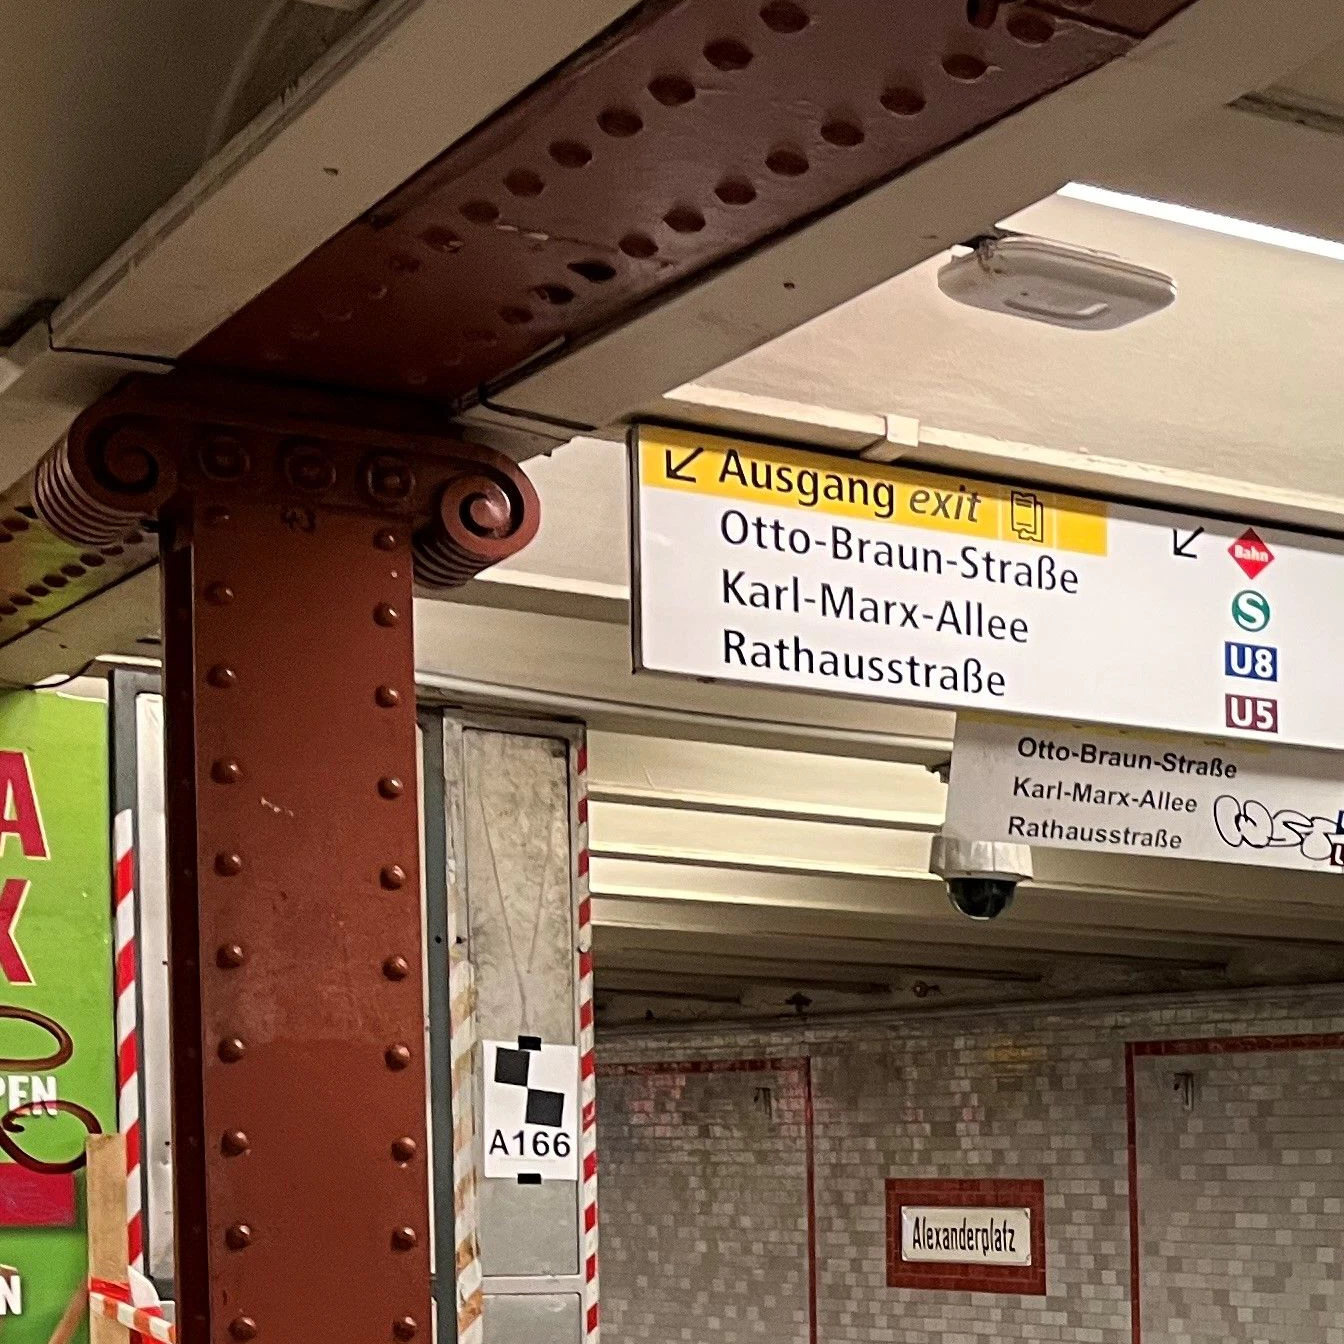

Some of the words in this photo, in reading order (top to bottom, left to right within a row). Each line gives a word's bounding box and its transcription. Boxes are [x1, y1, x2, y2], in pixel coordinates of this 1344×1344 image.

[719, 449, 895, 519] Ausgang
[909, 484, 982, 523] exit
[720, 509, 1079, 594] Otto-Braun-Straße
[1234, 544, 1269, 563] Bahn
[722, 569, 1029, 644] Karl-Marx-Allee
[1238, 592, 1265, 630] S
[723, 628, 1005, 697] Rathausstraße
[1230, 644, 1274, 679] U8
[1231, 697, 1274, 730] U5
[1017, 736, 1237, 779] Otto-Braun-Straße
[1013, 776, 1198, 813] Karl-Marx-Allee
[1008, 815, 1182, 849] Rathausstraße
[489, 1129, 571, 1157] A166
[913, 1216, 1016, 1256] Alexanderplatz
